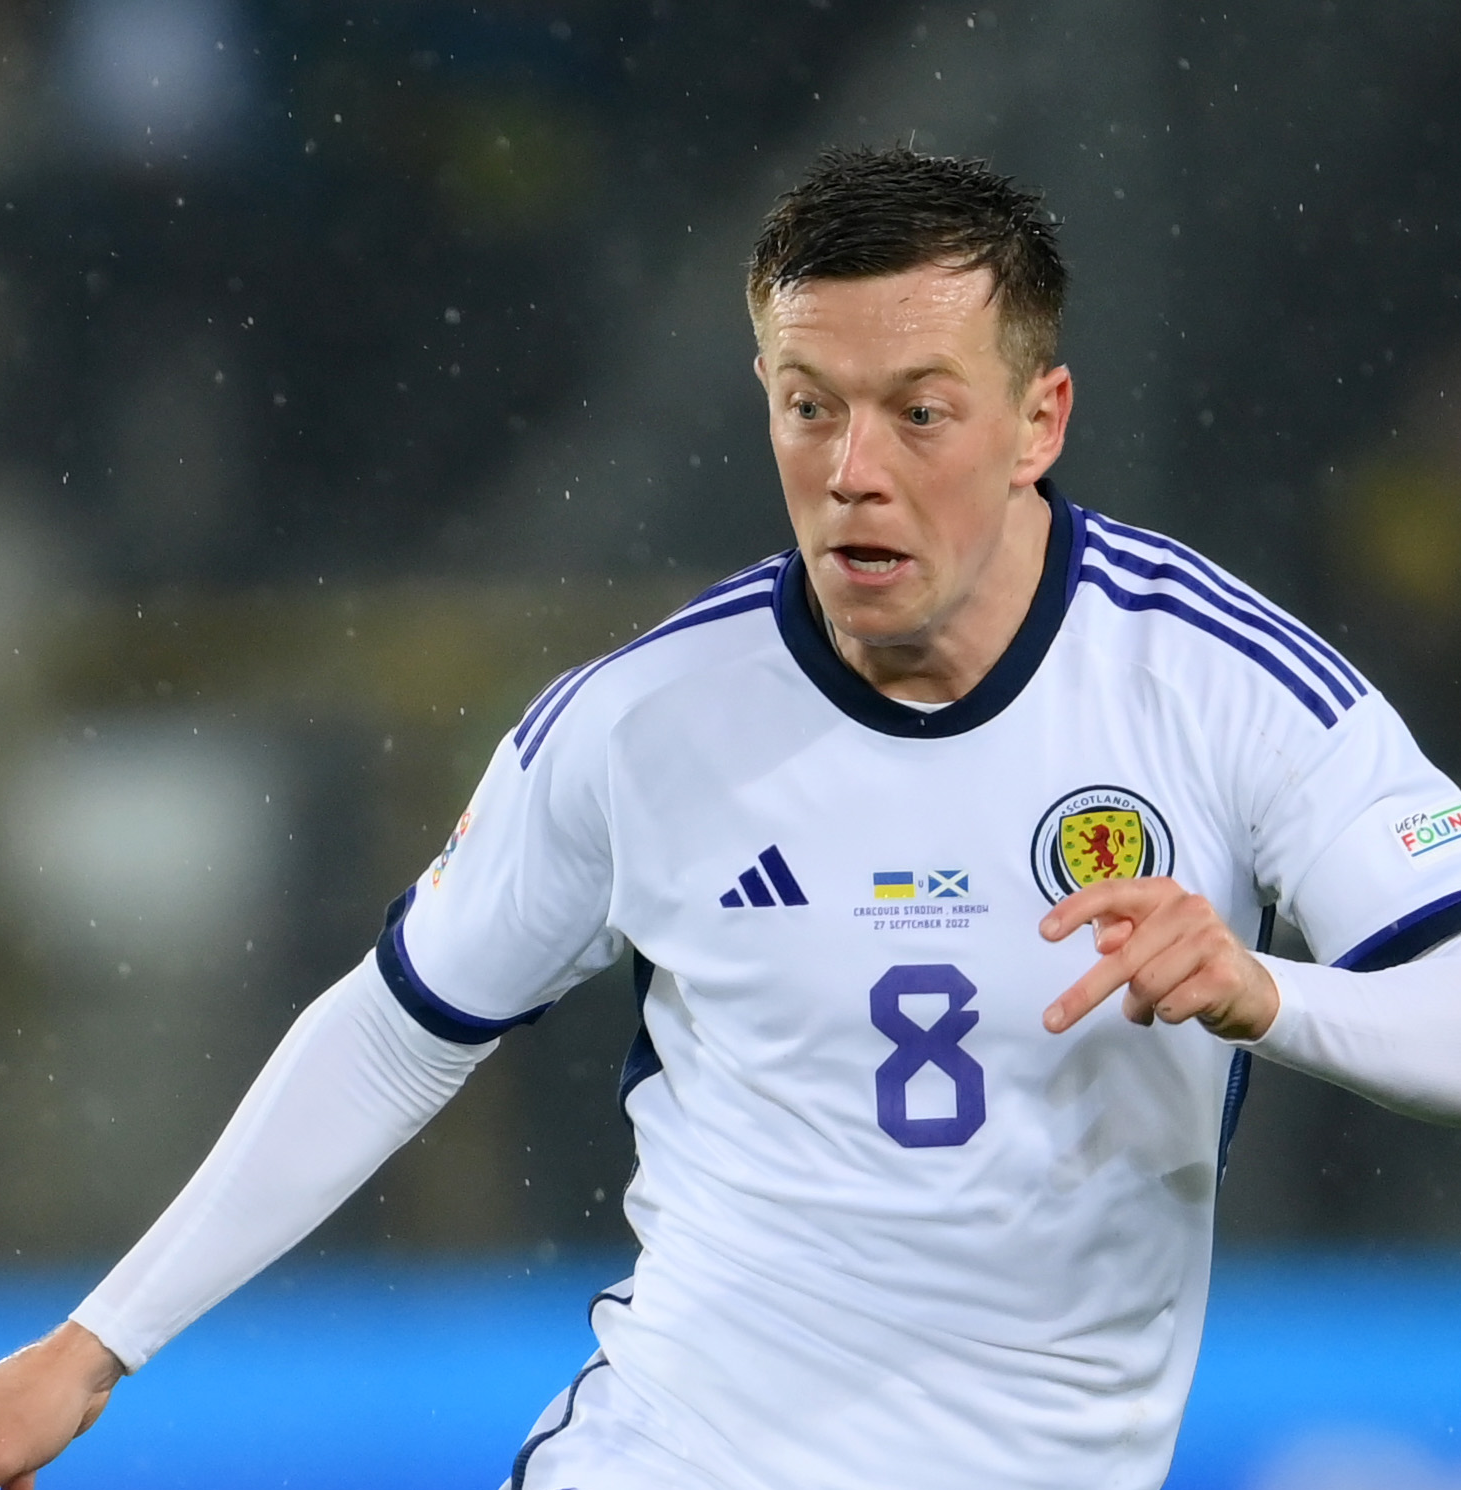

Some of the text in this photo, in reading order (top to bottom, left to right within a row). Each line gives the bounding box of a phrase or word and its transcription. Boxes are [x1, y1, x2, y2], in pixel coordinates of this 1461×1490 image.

[1066, 794, 1131, 813] SCOTLAND
[1395, 813, 1428, 833] UEFA
[853, 906, 900, 917] CRACOVIA
[952, 904, 989, 914] KRAKOW
[873, 918, 970, 930] 27 SEPTEMBER 2022
[869, 963, 986, 1148] 8
